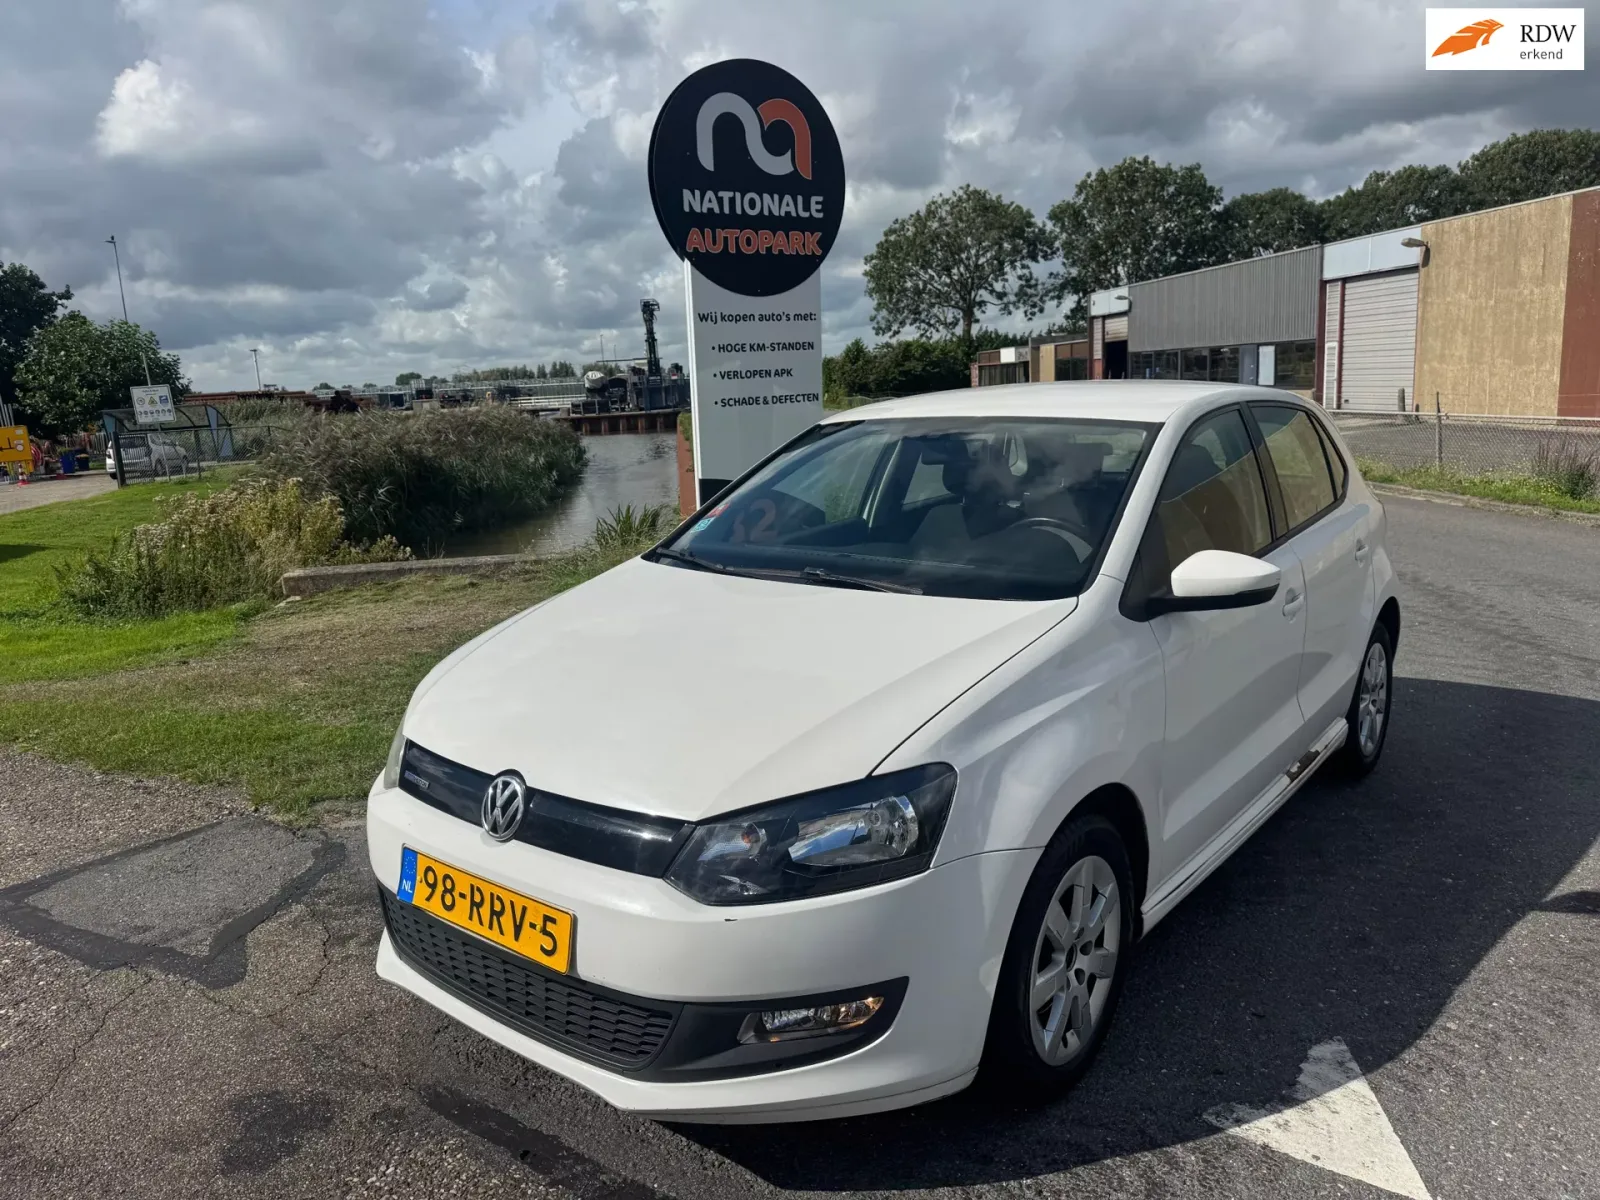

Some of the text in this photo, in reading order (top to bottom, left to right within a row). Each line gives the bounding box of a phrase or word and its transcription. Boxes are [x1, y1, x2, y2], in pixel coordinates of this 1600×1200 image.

[682, 188, 824, 218] NATIONALE
[686, 227, 822, 255] AUTOPARK
[698, 311, 817, 325] Wij kopen auto's met:
[718, 341, 815, 353] HOGE KM-STANDEN
[719, 368, 793, 380] VERLOPEN APK
[721, 393, 819, 408] SCHADE & DEFECTEN
[402, 878, 413, 894] NL
[423, 865, 558, 957] 98-RRV-5
